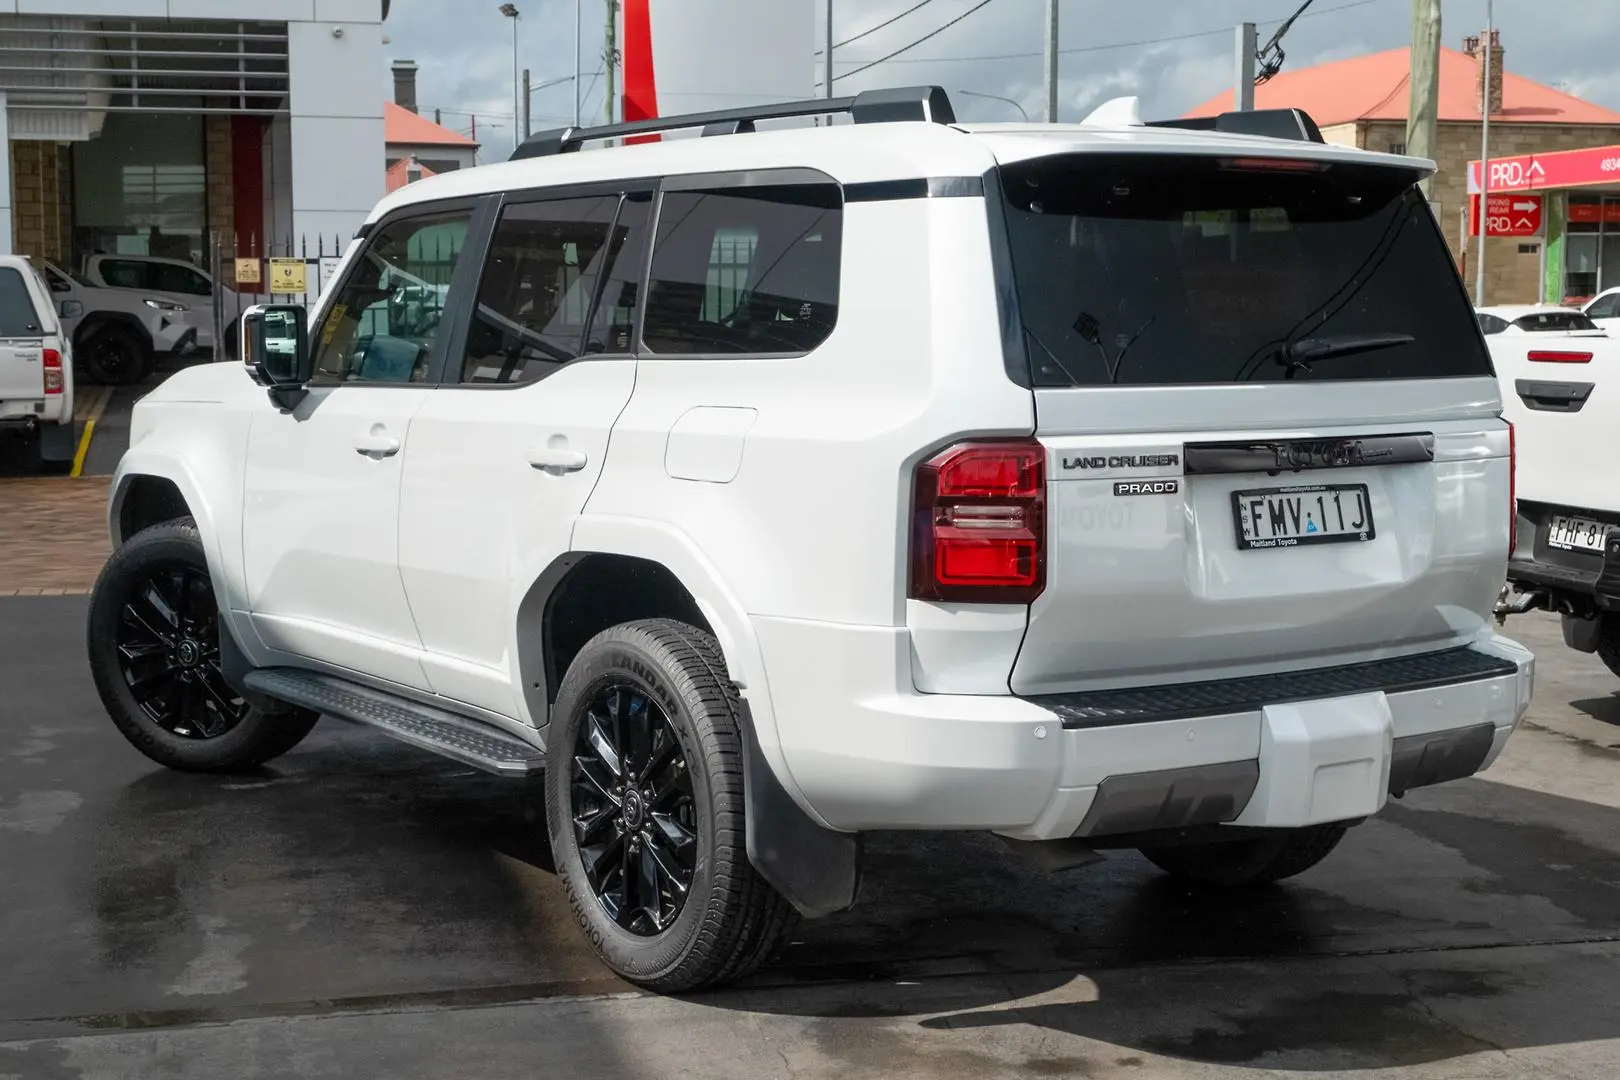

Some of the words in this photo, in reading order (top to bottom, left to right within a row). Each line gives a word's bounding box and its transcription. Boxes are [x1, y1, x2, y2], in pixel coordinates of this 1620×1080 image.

[1062, 456, 1106, 470] LAND
[1108, 454, 1179, 469] CRUISER
[1118, 482, 1176, 495] PRADO
[1250, 538, 1276, 548] Maitland
[1277, 537, 1298, 547] Toyota
[559, 861, 606, 954] YOKOHAMA
